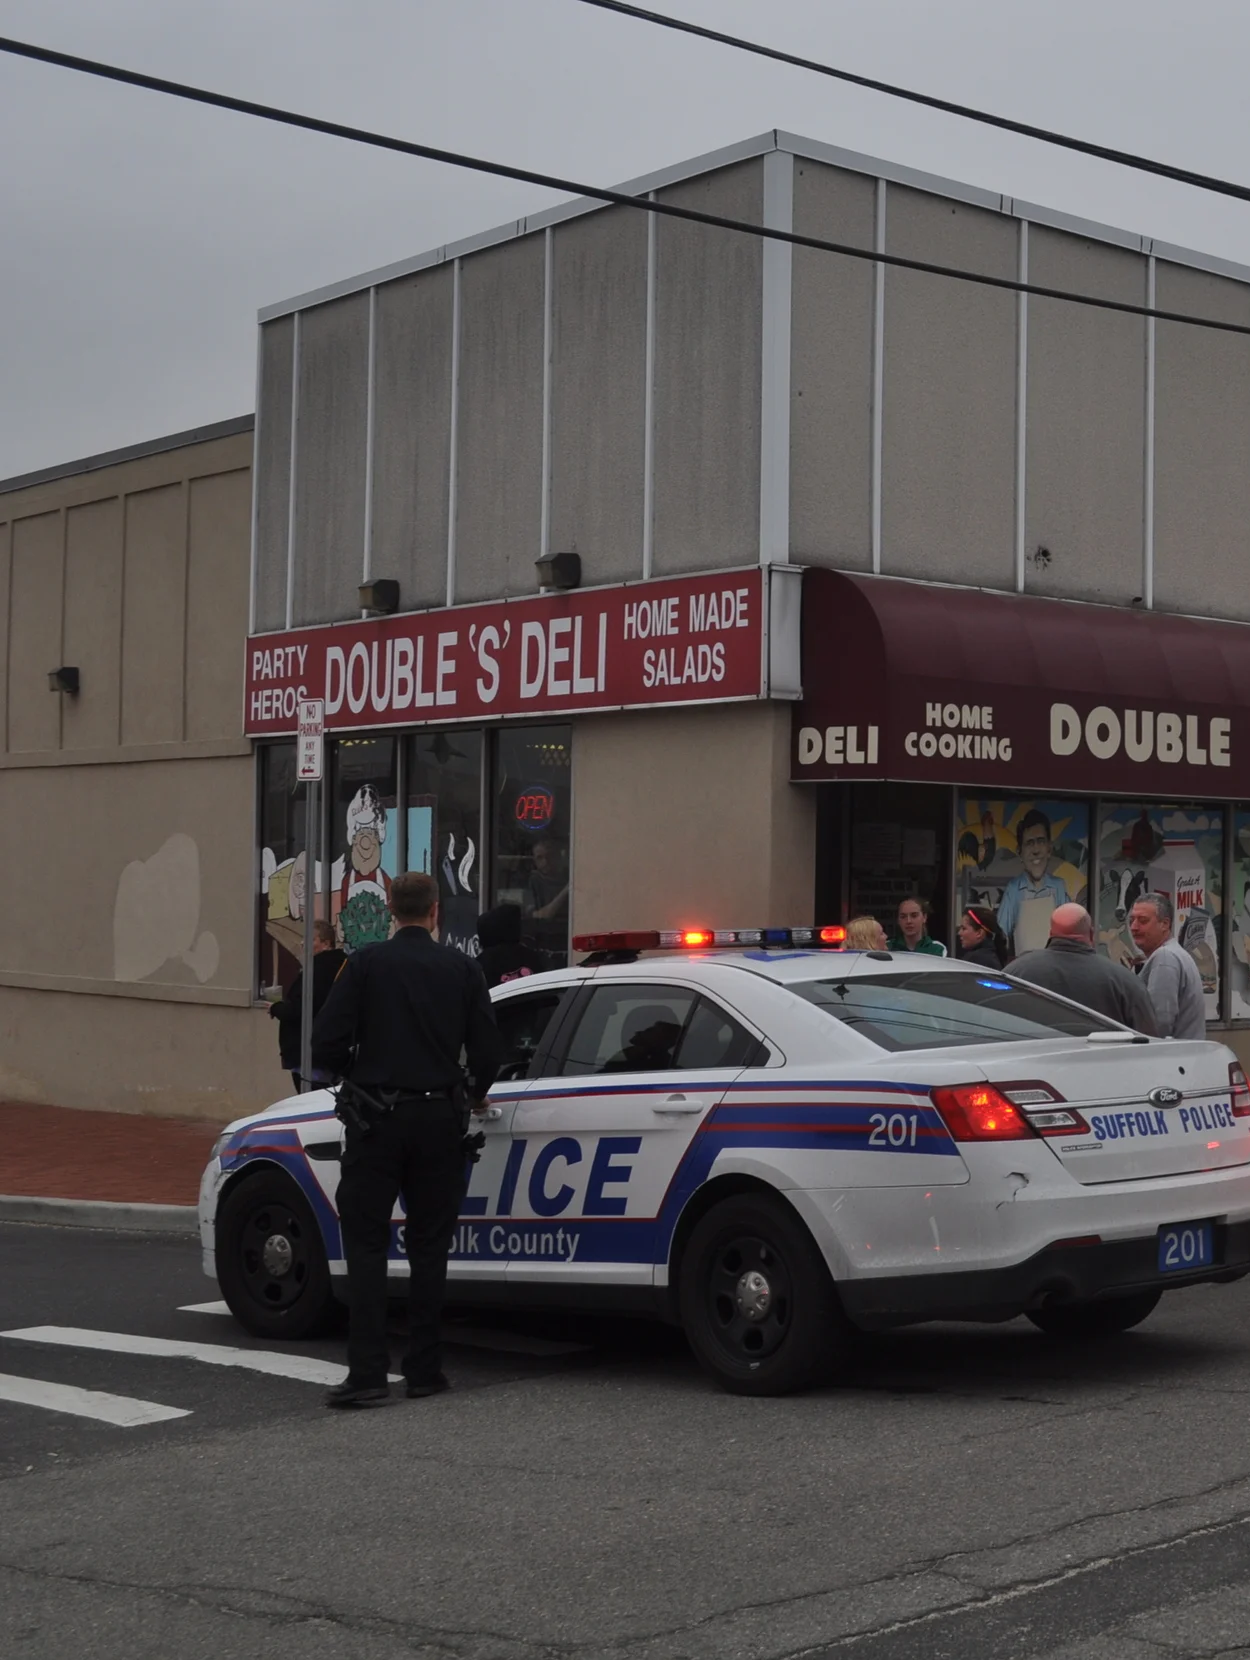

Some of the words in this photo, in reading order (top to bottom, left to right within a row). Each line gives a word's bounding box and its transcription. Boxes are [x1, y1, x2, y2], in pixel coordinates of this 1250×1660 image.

[624, 597, 680, 640] HOME
[689, 588, 749, 632] MADE
[253, 645, 308, 681] PARTY
[325, 631, 458, 715] DOUBLE
[520, 612, 607, 698] DELI
[643, 642, 726, 688] SALADS
[306, 704, 316, 719] NO
[926, 702, 993, 730] HOME
[300, 723, 321, 737] PARKING
[306, 741, 315, 750] ANY
[799, 726, 879, 764] DELI
[904, 732, 1013, 762] COOKING
[1050, 703, 1231, 767] DOUBLE
[515, 795, 553, 820] OPEN
[1177, 889, 1203, 910] MILK
[1160, 1089, 1178, 1101] Ford
[868, 1113, 918, 1147] 201
[1091, 1110, 1169, 1141] SUFFOLK
[1179, 1103, 1236, 1133] POLICE
[489, 1225, 580, 1263] County
[1164, 1228, 1205, 1264] 201
